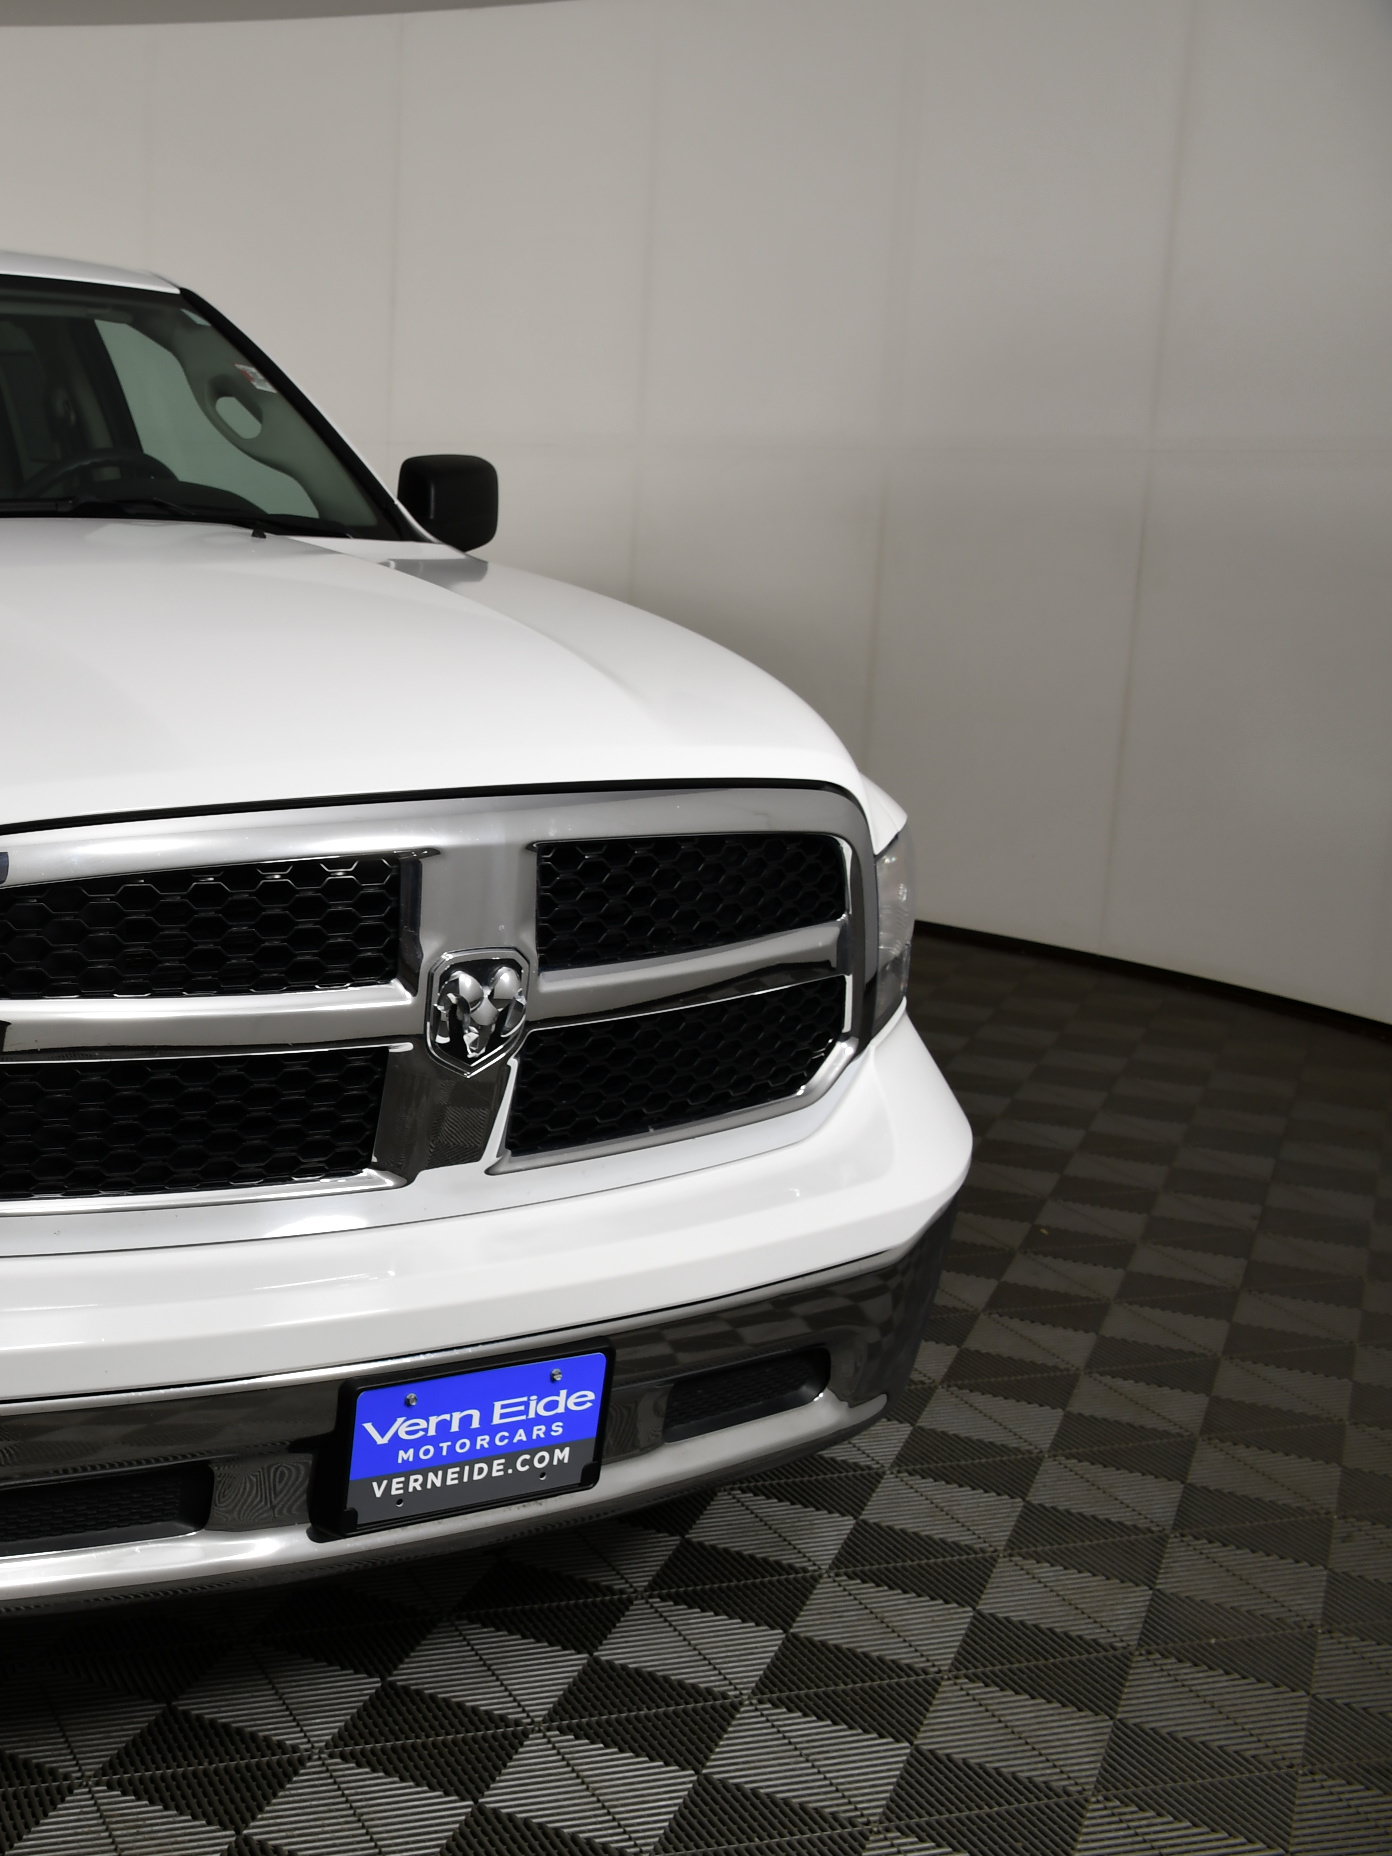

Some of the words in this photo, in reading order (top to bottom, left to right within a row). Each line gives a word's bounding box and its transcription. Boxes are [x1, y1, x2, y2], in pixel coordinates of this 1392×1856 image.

[362, 1407, 480, 1445] Vern
[491, 1389, 596, 1424] Eide
[397, 1422, 564, 1463] MOTORCARS
[372, 1447, 571, 1498] VERNEIDE.COM
